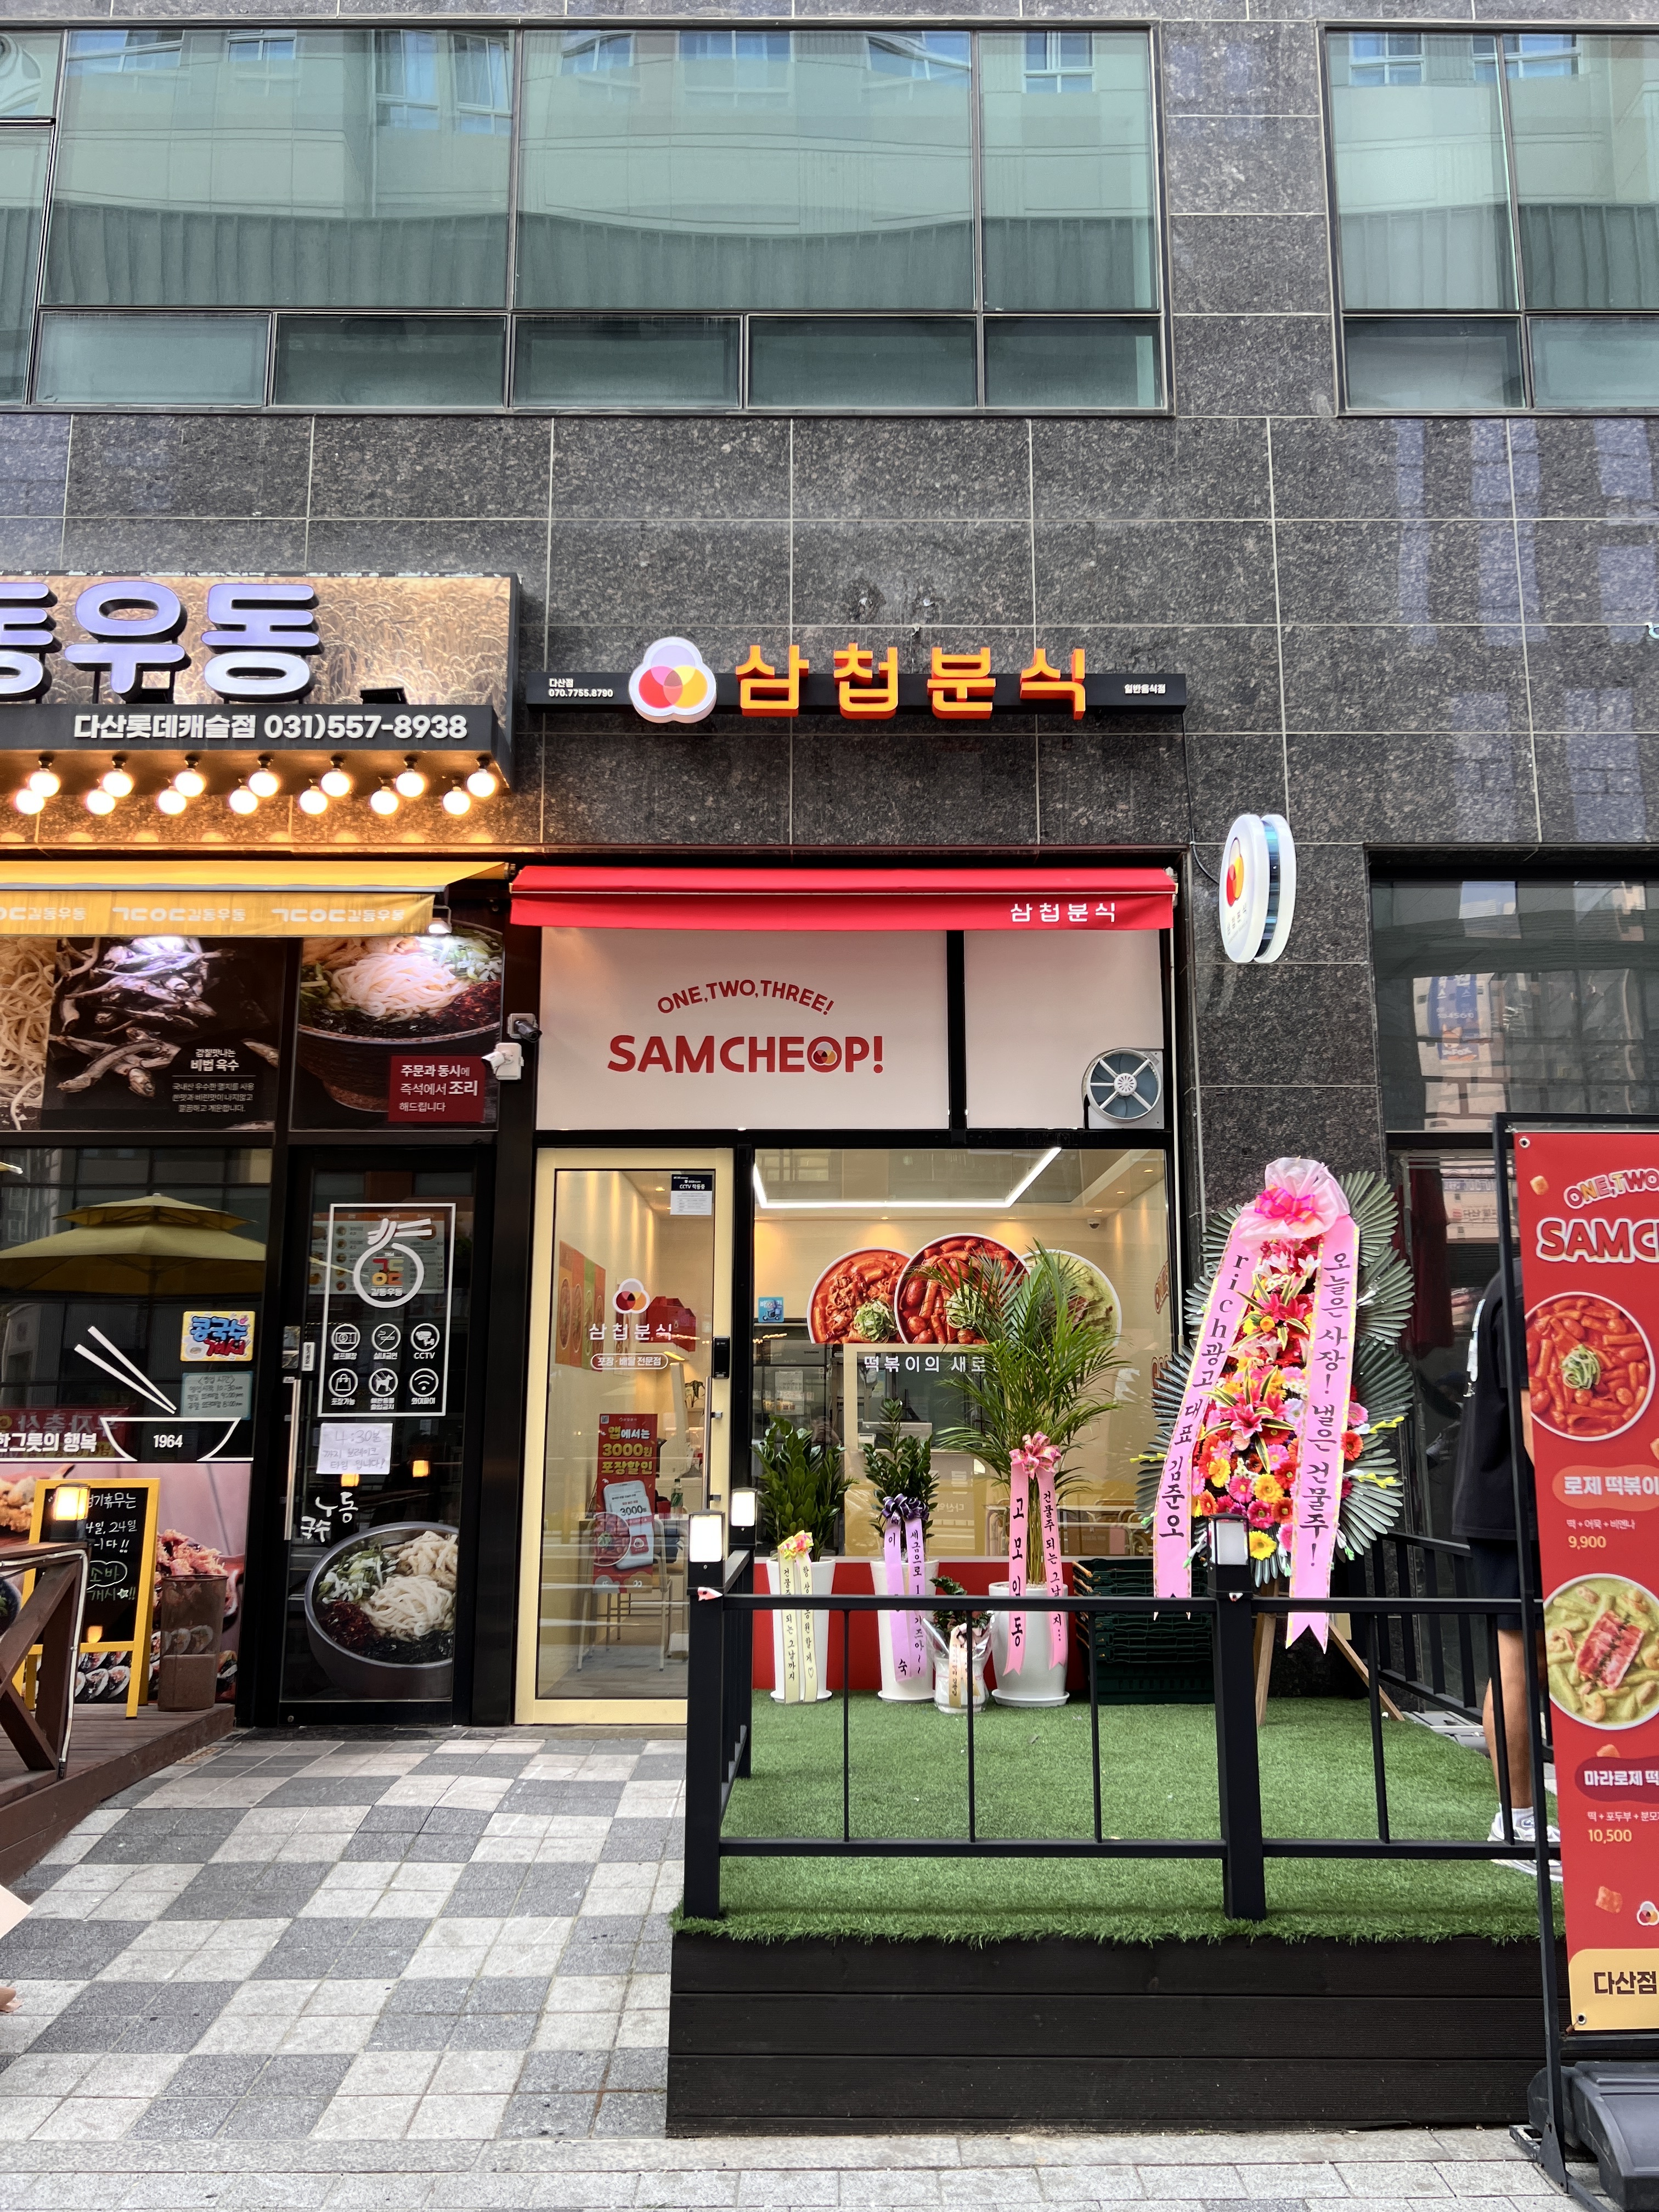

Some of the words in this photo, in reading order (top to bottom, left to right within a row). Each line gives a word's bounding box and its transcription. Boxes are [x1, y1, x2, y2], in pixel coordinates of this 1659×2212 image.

[549, 678, 574, 687] 다산점
[736, 643, 1085, 714] 삼첩분식
[548, 689, 613, 698] 070.7755.8790
[1124, 684, 1166, 694] 일반음식점
[74, 715, 256, 739] 다산롯데캐슬점
[264, 715, 467, 739] 031)557-8938
[1010, 902, 1115, 923] 삼첩분식
[607, 1035, 883, 1073] SAMCHEOP!
[190, 1059, 214, 1071] 비법
[216, 1059, 240, 1071] 육수
[400, 1064, 436, 1077] 주문과
[438, 1064, 470, 1077] 동시에
[400, 1083, 447, 1096] 즉석에서
[448, 1080, 478, 1096] 조리
[399, 1102, 446, 1112] 해드립니다
[1537, 1217, 1659, 1263] SAMC
[1321, 1252, 1350, 1318] 오늘은
[190, 1316, 247, 1342] 콩국수
[589, 1322, 673, 1341] 삼첩분식
[597, 1356, 614, 1366] 포장
[619, 1356, 635, 1366] 배달
[636, 1356, 662, 1366] 전문점
[864, 1356, 940, 1373] 떡볶이의
[951, 1356, 992, 1373] 새로
[1314, 1325, 1347, 1395] 사장!
[1174, 1398, 1203, 1446] 대표
[1306, 1403, 1337, 1452] 낼은
[63, 1432, 97, 1453] 행복
[153, 1434, 183, 1448] 1964
[607, 1426, 650, 1440] 앱에서는
[602, 1443, 653, 1458] 3000원
[601, 1460, 653, 1475] 포장할인
[1564, 1476, 1602, 1495] 로제
[1604, 1476, 1659, 1496] 떡볶이
[1159, 1455, 1185, 1538] 김준오
[1043, 1490, 1055, 1532] 건물주
[1300, 1461, 1333, 1567] 건물주!
[109, 1519, 138, 1533] 24일
[301, 1515, 331, 1542] 국수
[1584, 1519, 1602, 1530] 어묵
[1610, 1519, 1635, 1530] 비엔나
[1046, 1537, 1058, 1565] 되는
[1568, 1535, 1607, 1550] 9,900
[910, 1530, 923, 1577] 세금으로
[89, 1564, 120, 1582] 소바
[803, 1566, 810, 1594] 항상
[786, 1613, 794, 1634] 되는
[1583, 1770, 1643, 1786] 마라로제
[1587, 1811, 1598, 1822] 떡
[1606, 1811, 1632, 1822] 포두부
[1641, 1811, 1659, 1822] 분모
[1588, 1829, 1633, 1844] 10,500
[1593, 1970, 1657, 1995] 다산점
